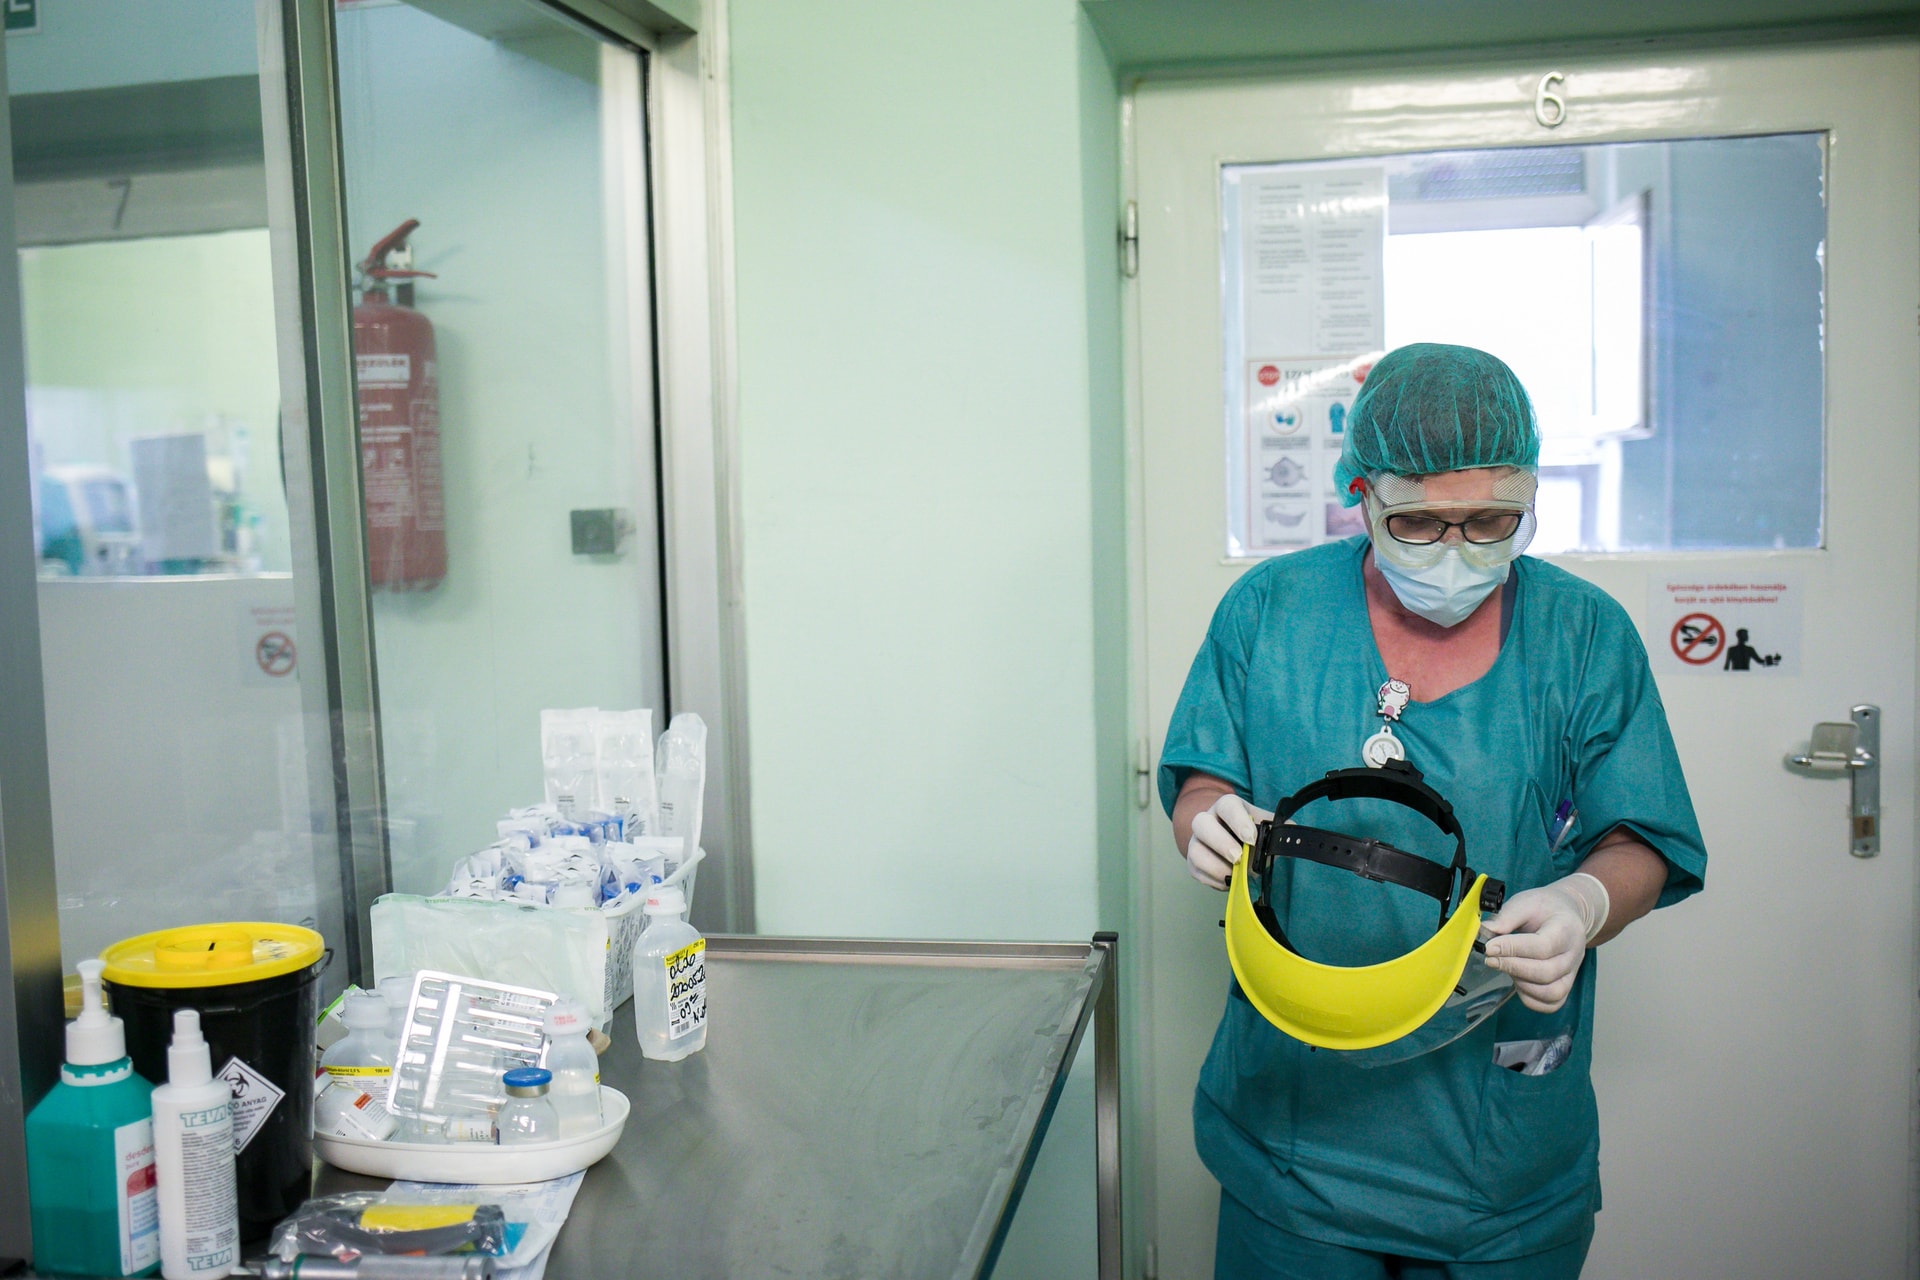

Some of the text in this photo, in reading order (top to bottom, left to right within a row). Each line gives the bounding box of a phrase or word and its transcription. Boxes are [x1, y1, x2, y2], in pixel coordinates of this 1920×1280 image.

[1536, 71, 1566, 129] 6
[107, 179, 131, 231] 7
[241, 1096, 267, 1108] ANYAG
[180, 1104, 227, 1128] TEVA
[187, 1247, 233, 1271] TEVA
